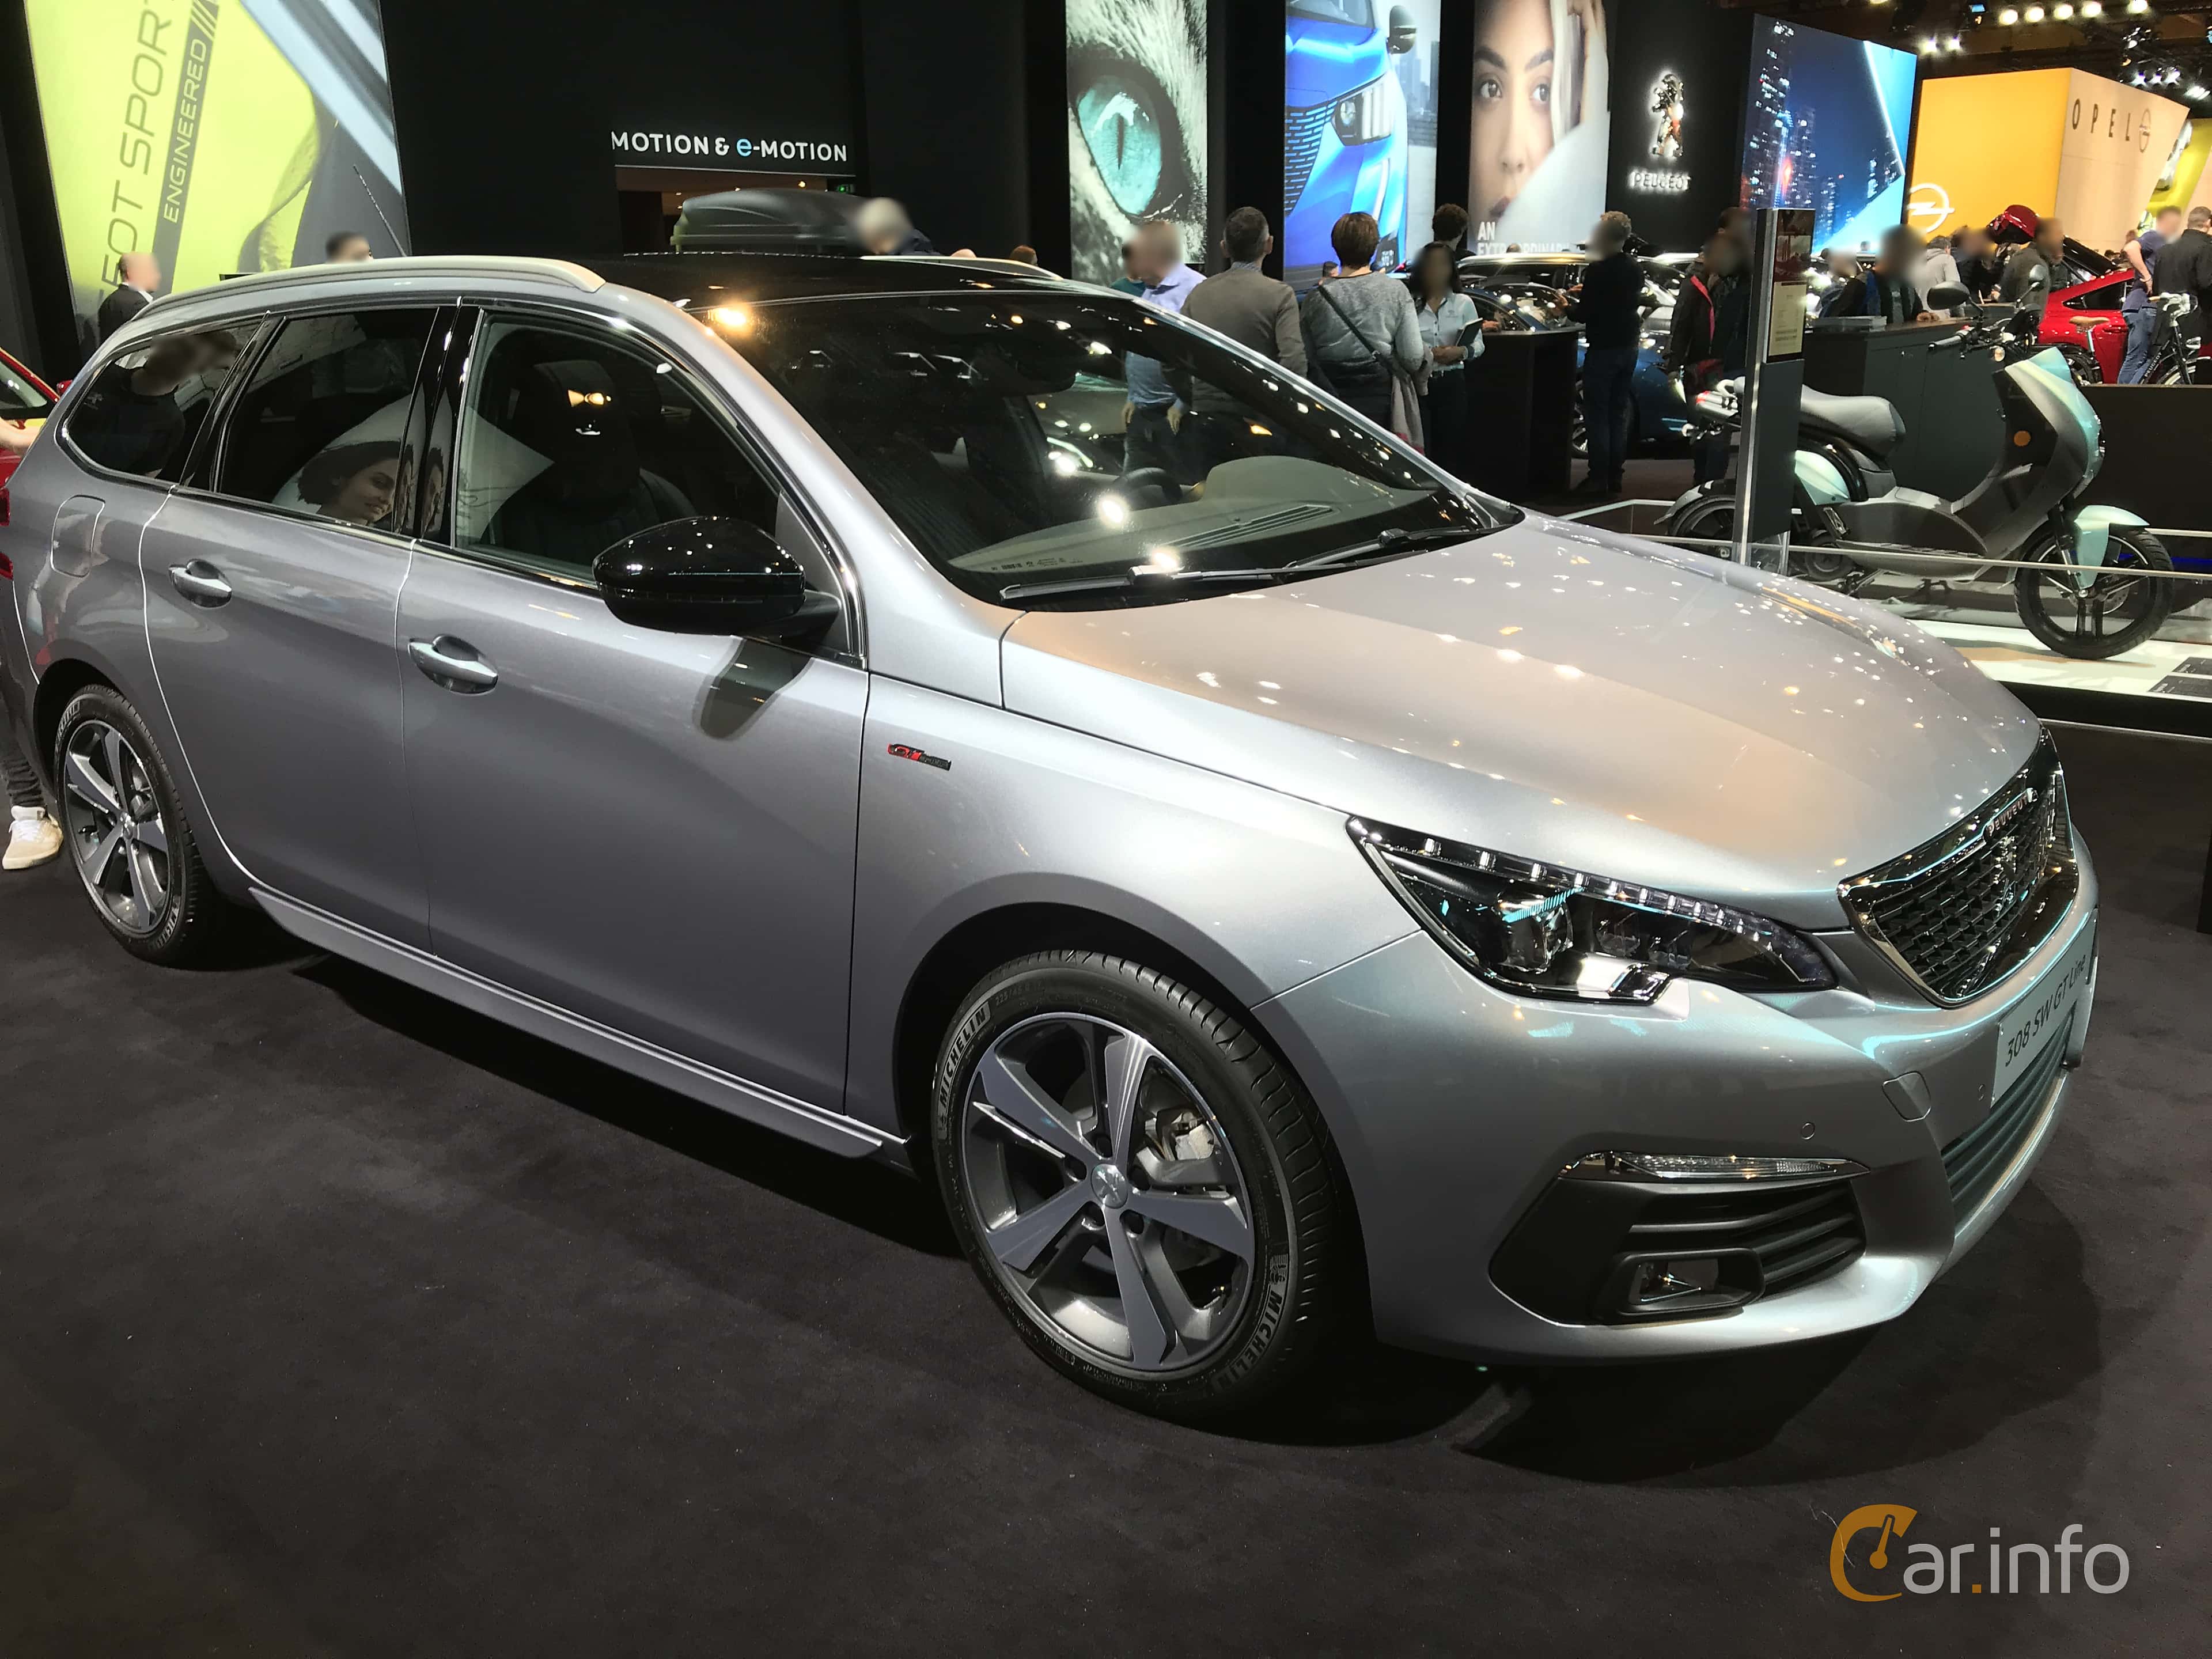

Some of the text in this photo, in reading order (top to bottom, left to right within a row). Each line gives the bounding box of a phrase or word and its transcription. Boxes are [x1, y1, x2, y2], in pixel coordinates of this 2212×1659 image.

[163, 38, 207, 224] ENGINEERED
[2072, 98, 2131, 141] OPEL
[99, 0, 172, 298] EOT SPOR
[611, 131, 847, 162] MOTION & e-MOTION
[1632, 171, 1692, 192] PEUGEOT
[1477, 221, 1496, 240] AN
[2144, 352, 2161, 377] PEUGEOT
[2005, 954, 2086, 1067] 308 SW GT Line
[940, 1008, 986, 1108] MICHELIN
